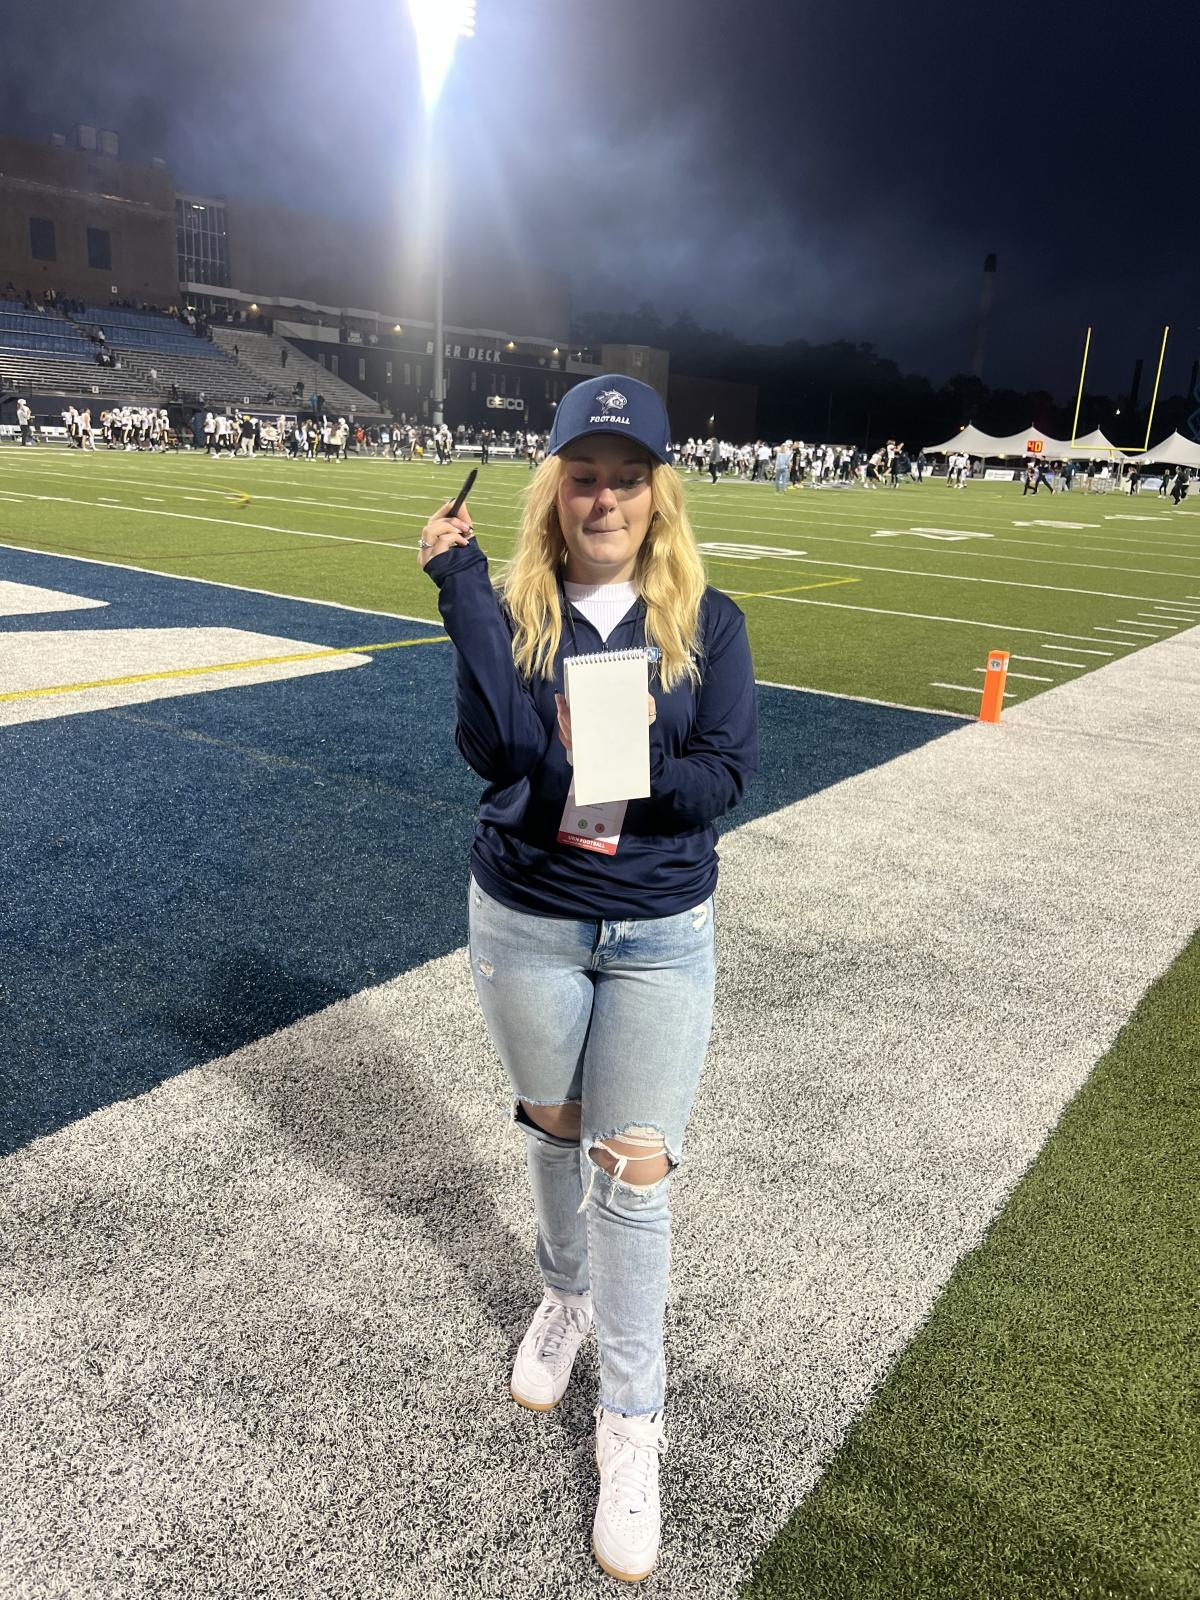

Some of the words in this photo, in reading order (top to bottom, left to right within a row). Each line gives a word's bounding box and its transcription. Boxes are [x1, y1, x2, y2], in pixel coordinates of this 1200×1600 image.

[426, 341, 461, 357] BER
[468, 347, 501, 363] DECK
[486, 396, 524, 410] GEICO
[589, 415, 631, 425] FOOTBALL
[1028, 441, 1043, 452] 40
[580, 838, 606, 849] FOOTBALL
